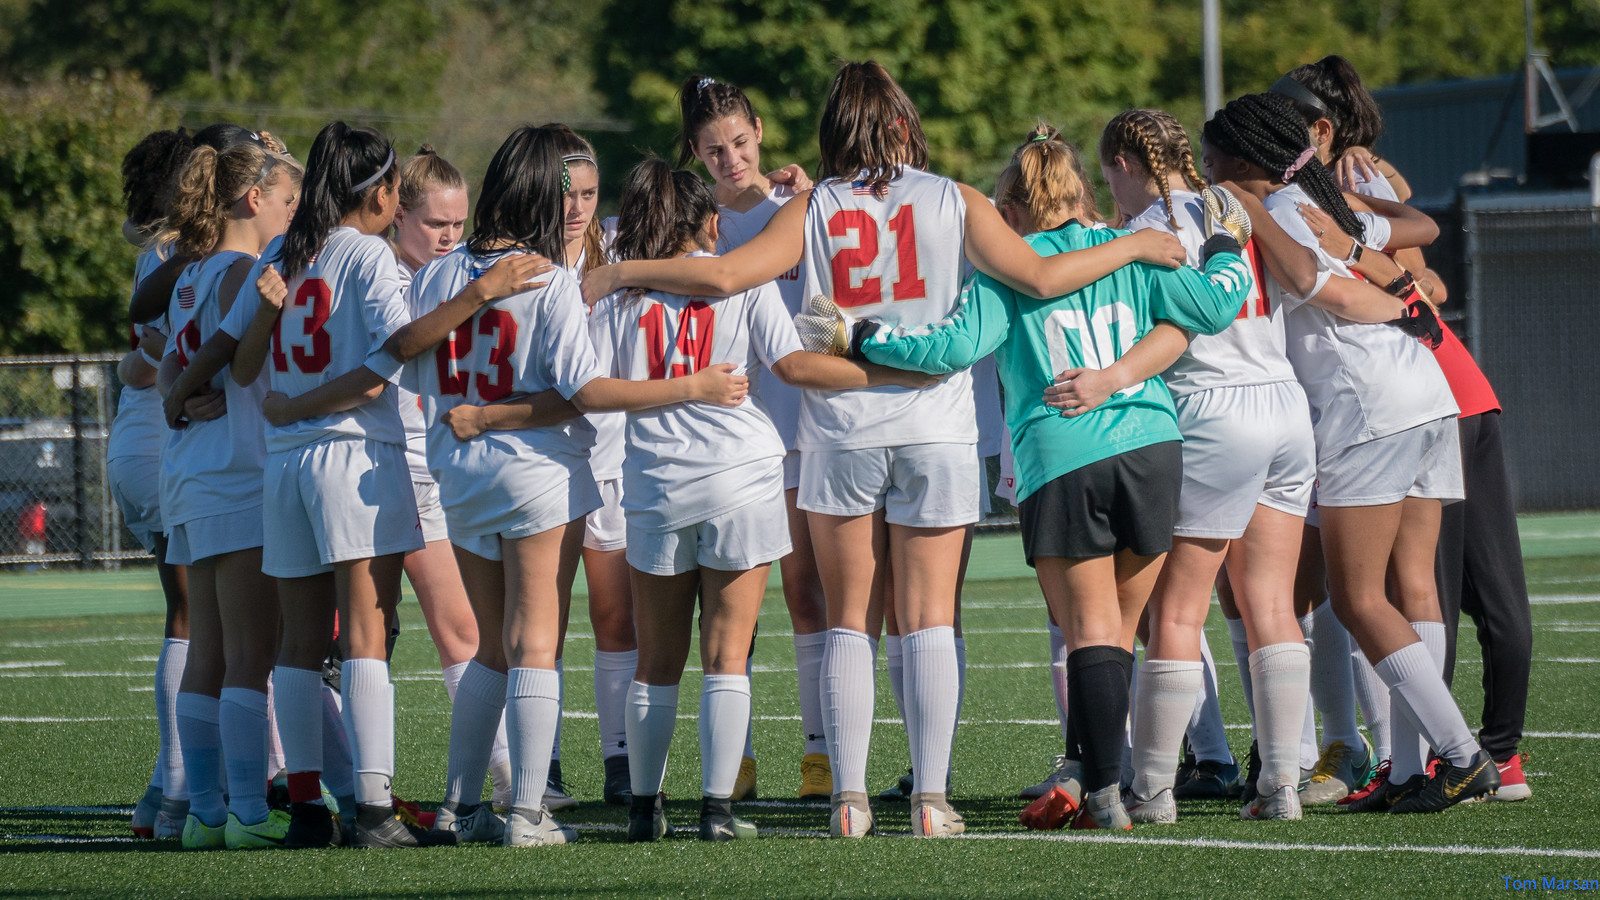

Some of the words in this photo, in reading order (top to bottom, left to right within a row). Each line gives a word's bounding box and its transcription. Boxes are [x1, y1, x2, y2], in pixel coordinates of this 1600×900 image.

[827, 203, 927, 309] 21
[435, 301, 519, 402] 23
[638, 299, 716, 380] 19
[449, 816, 475, 833] CR7
